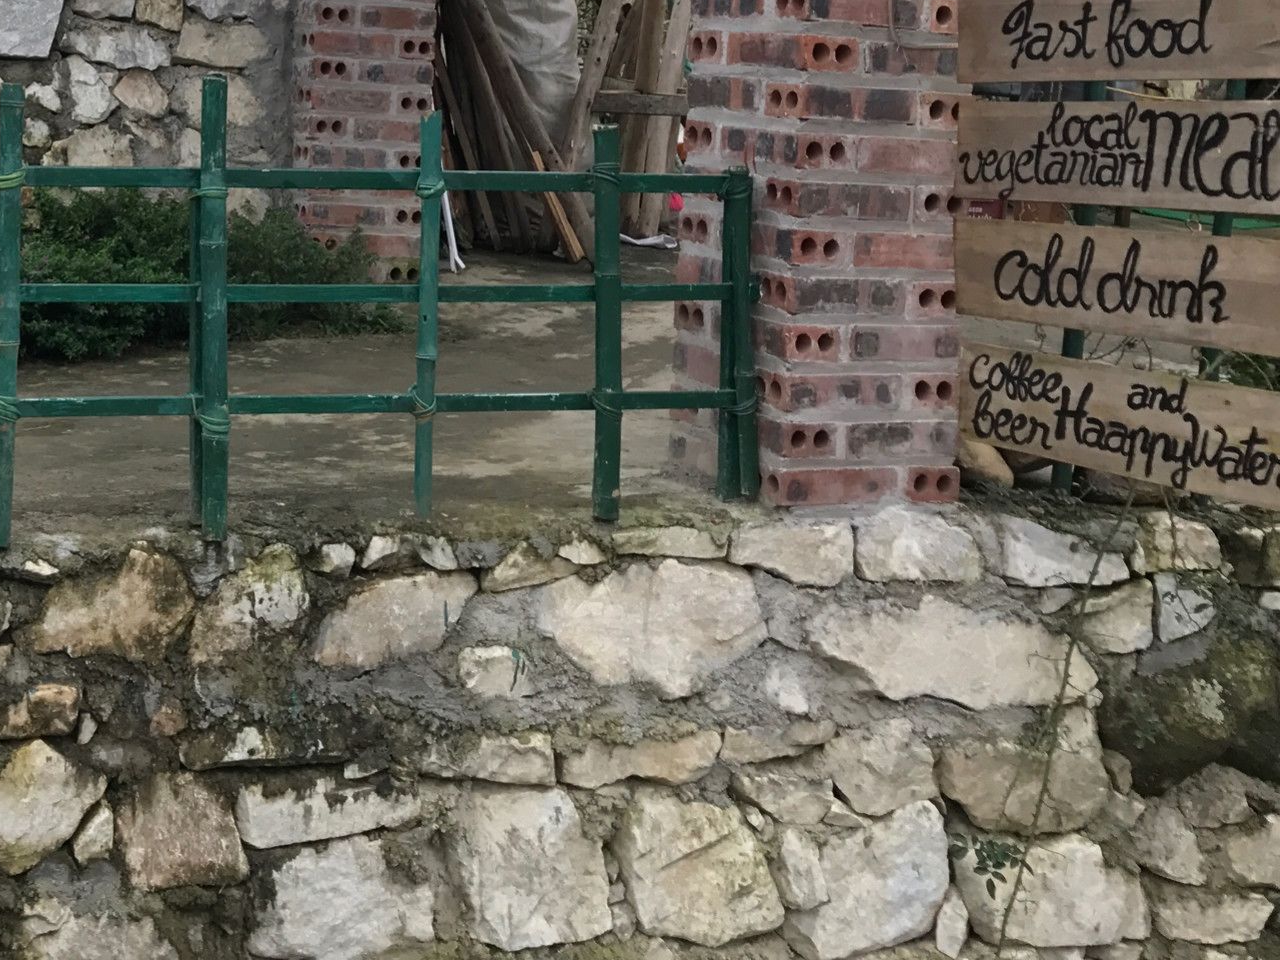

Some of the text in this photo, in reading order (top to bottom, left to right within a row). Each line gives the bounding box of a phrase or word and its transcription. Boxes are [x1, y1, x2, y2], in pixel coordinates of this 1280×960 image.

[1046, 101, 1139, 151] local
[959, 131, 1146, 199] vegetarian
[1097, 237, 1230, 323] drink
[972, 389, 1053, 450] beer
[1127, 377, 1189, 415] and
